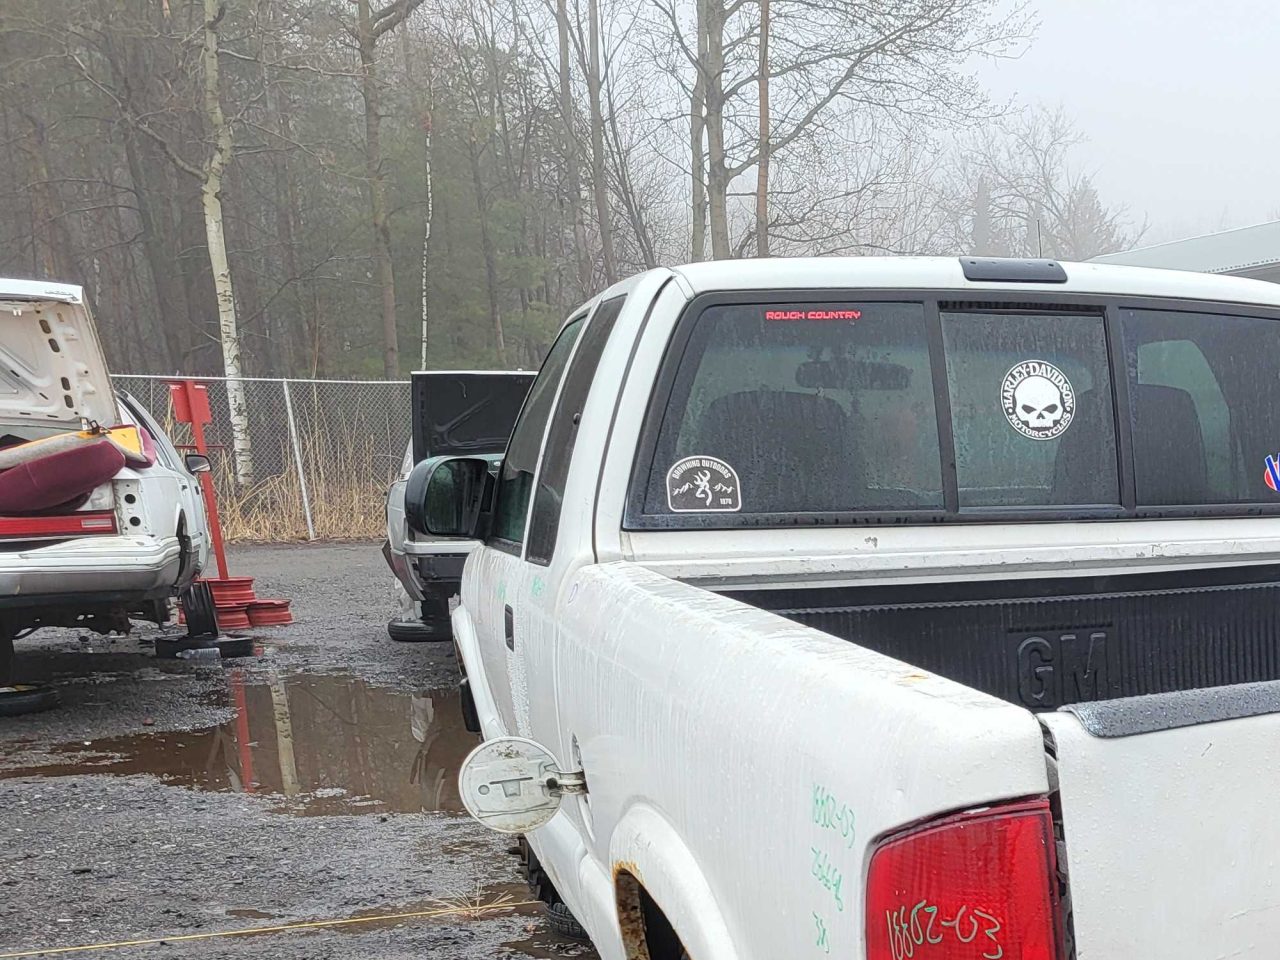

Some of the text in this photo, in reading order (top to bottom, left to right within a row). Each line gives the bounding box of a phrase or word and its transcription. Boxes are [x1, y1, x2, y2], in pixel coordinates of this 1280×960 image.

[766, 307, 861, 319] ROUGH COUNTRY
[1009, 412, 1072, 438] MOTORCYCLES
[701, 460, 732, 479] OUTDOORS
[1018, 632, 1109, 708] GM
